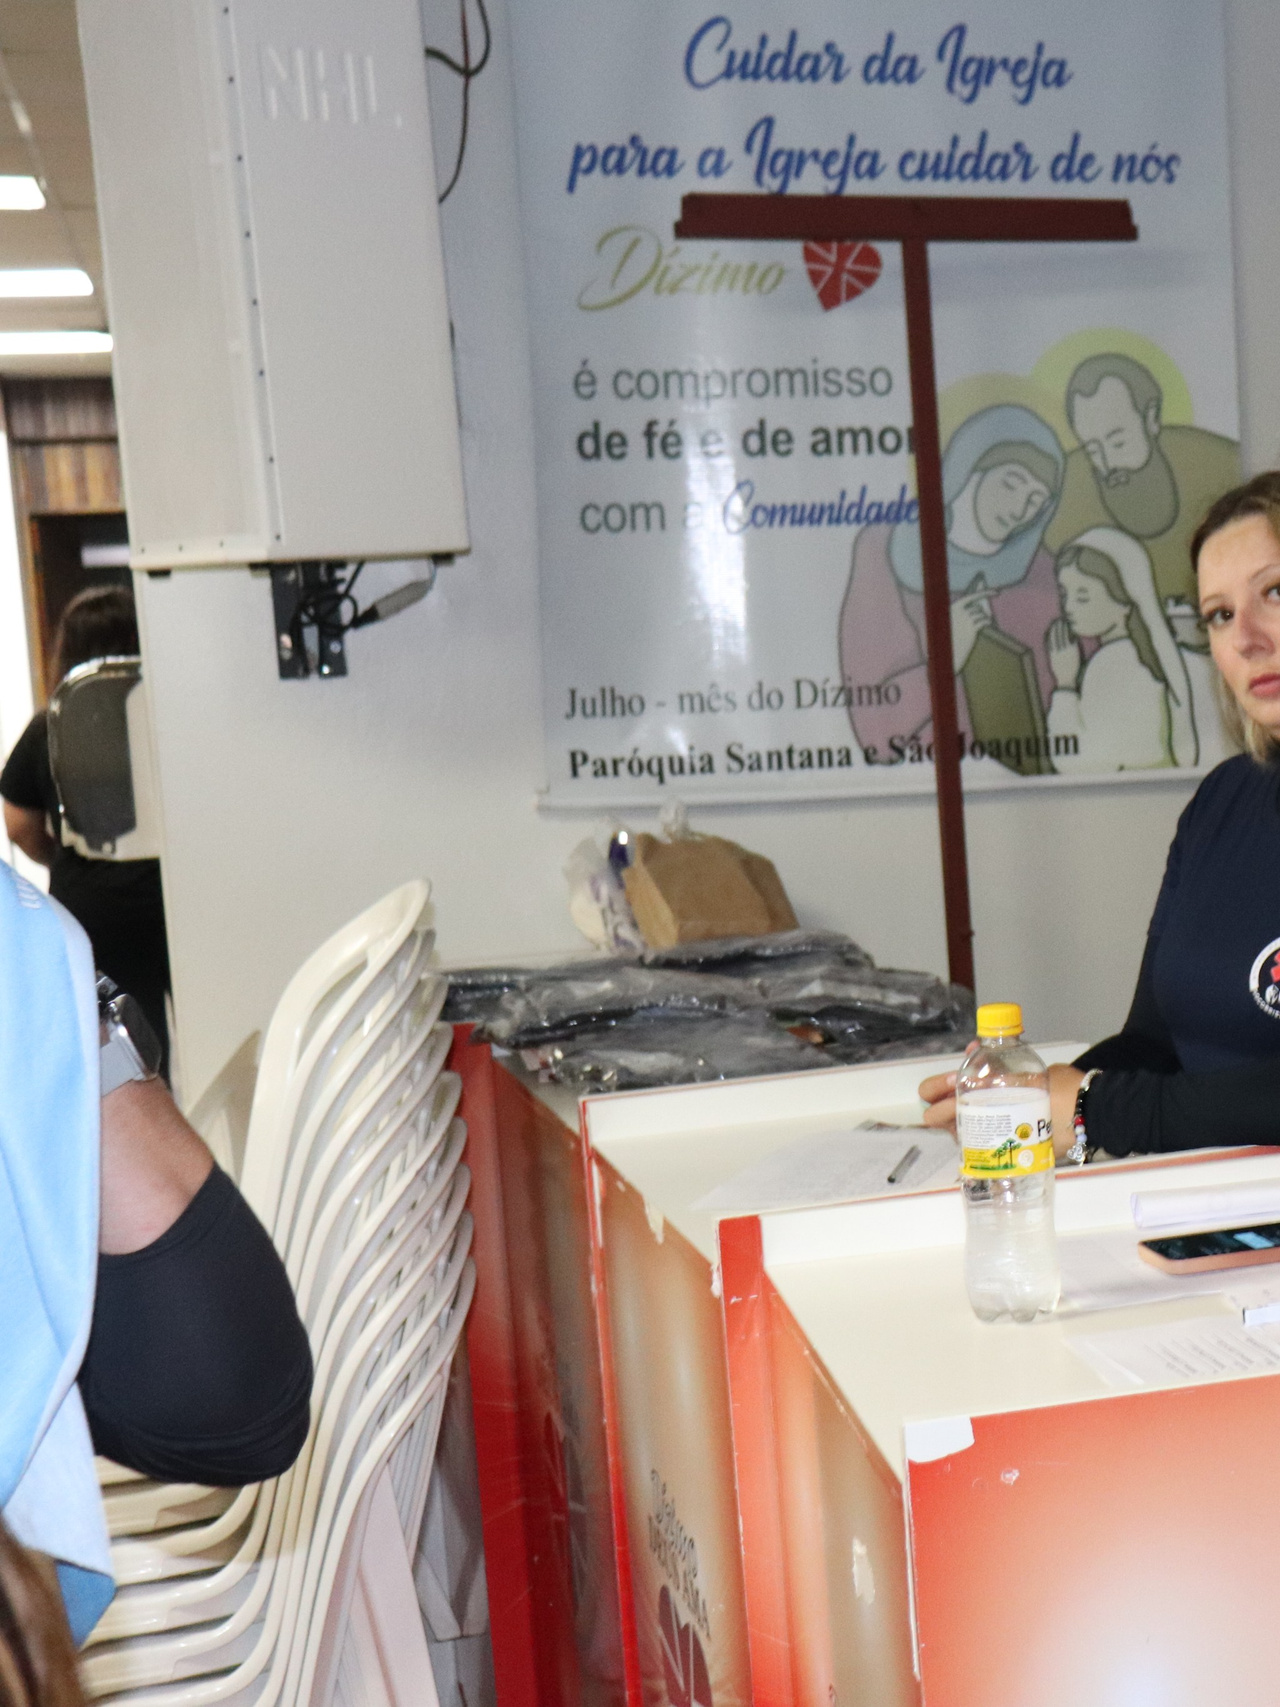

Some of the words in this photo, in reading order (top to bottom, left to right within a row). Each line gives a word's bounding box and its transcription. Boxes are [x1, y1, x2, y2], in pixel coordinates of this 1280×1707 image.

[684, 15, 849, 90] Cuidar
[862, 31, 926, 85] da
[936, 22, 1073, 105] Igreja
[566, 133, 684, 194] para
[697, 146, 733, 178] a
[744, 115, 886, 194] Igreja
[898, 129, 1039, 183] cuidar
[1050, 131, 1103, 184] de
[1112, 142, 1181, 185] nós
[577, 223, 786, 311] Dízimo
[573, 358, 597, 400] é
[612, 357, 893, 408] compromisso
[576, 420, 628, 460] de
[643, 418, 683, 460] fé
[700, 427, 724, 458] e
[742, 418, 794, 458] de
[579, 501, 666, 533] com
[722, 479, 919, 535] Comunidade
[565, 687, 646, 720] Julho
[677, 684, 738, 715] mês
[747, 680, 784, 712] do
[793, 676, 902, 711] Dízimo
[568, 745, 715, 785] Paróquia
[726, 743, 853, 774] Santana
[862, 747, 878, 766] e
